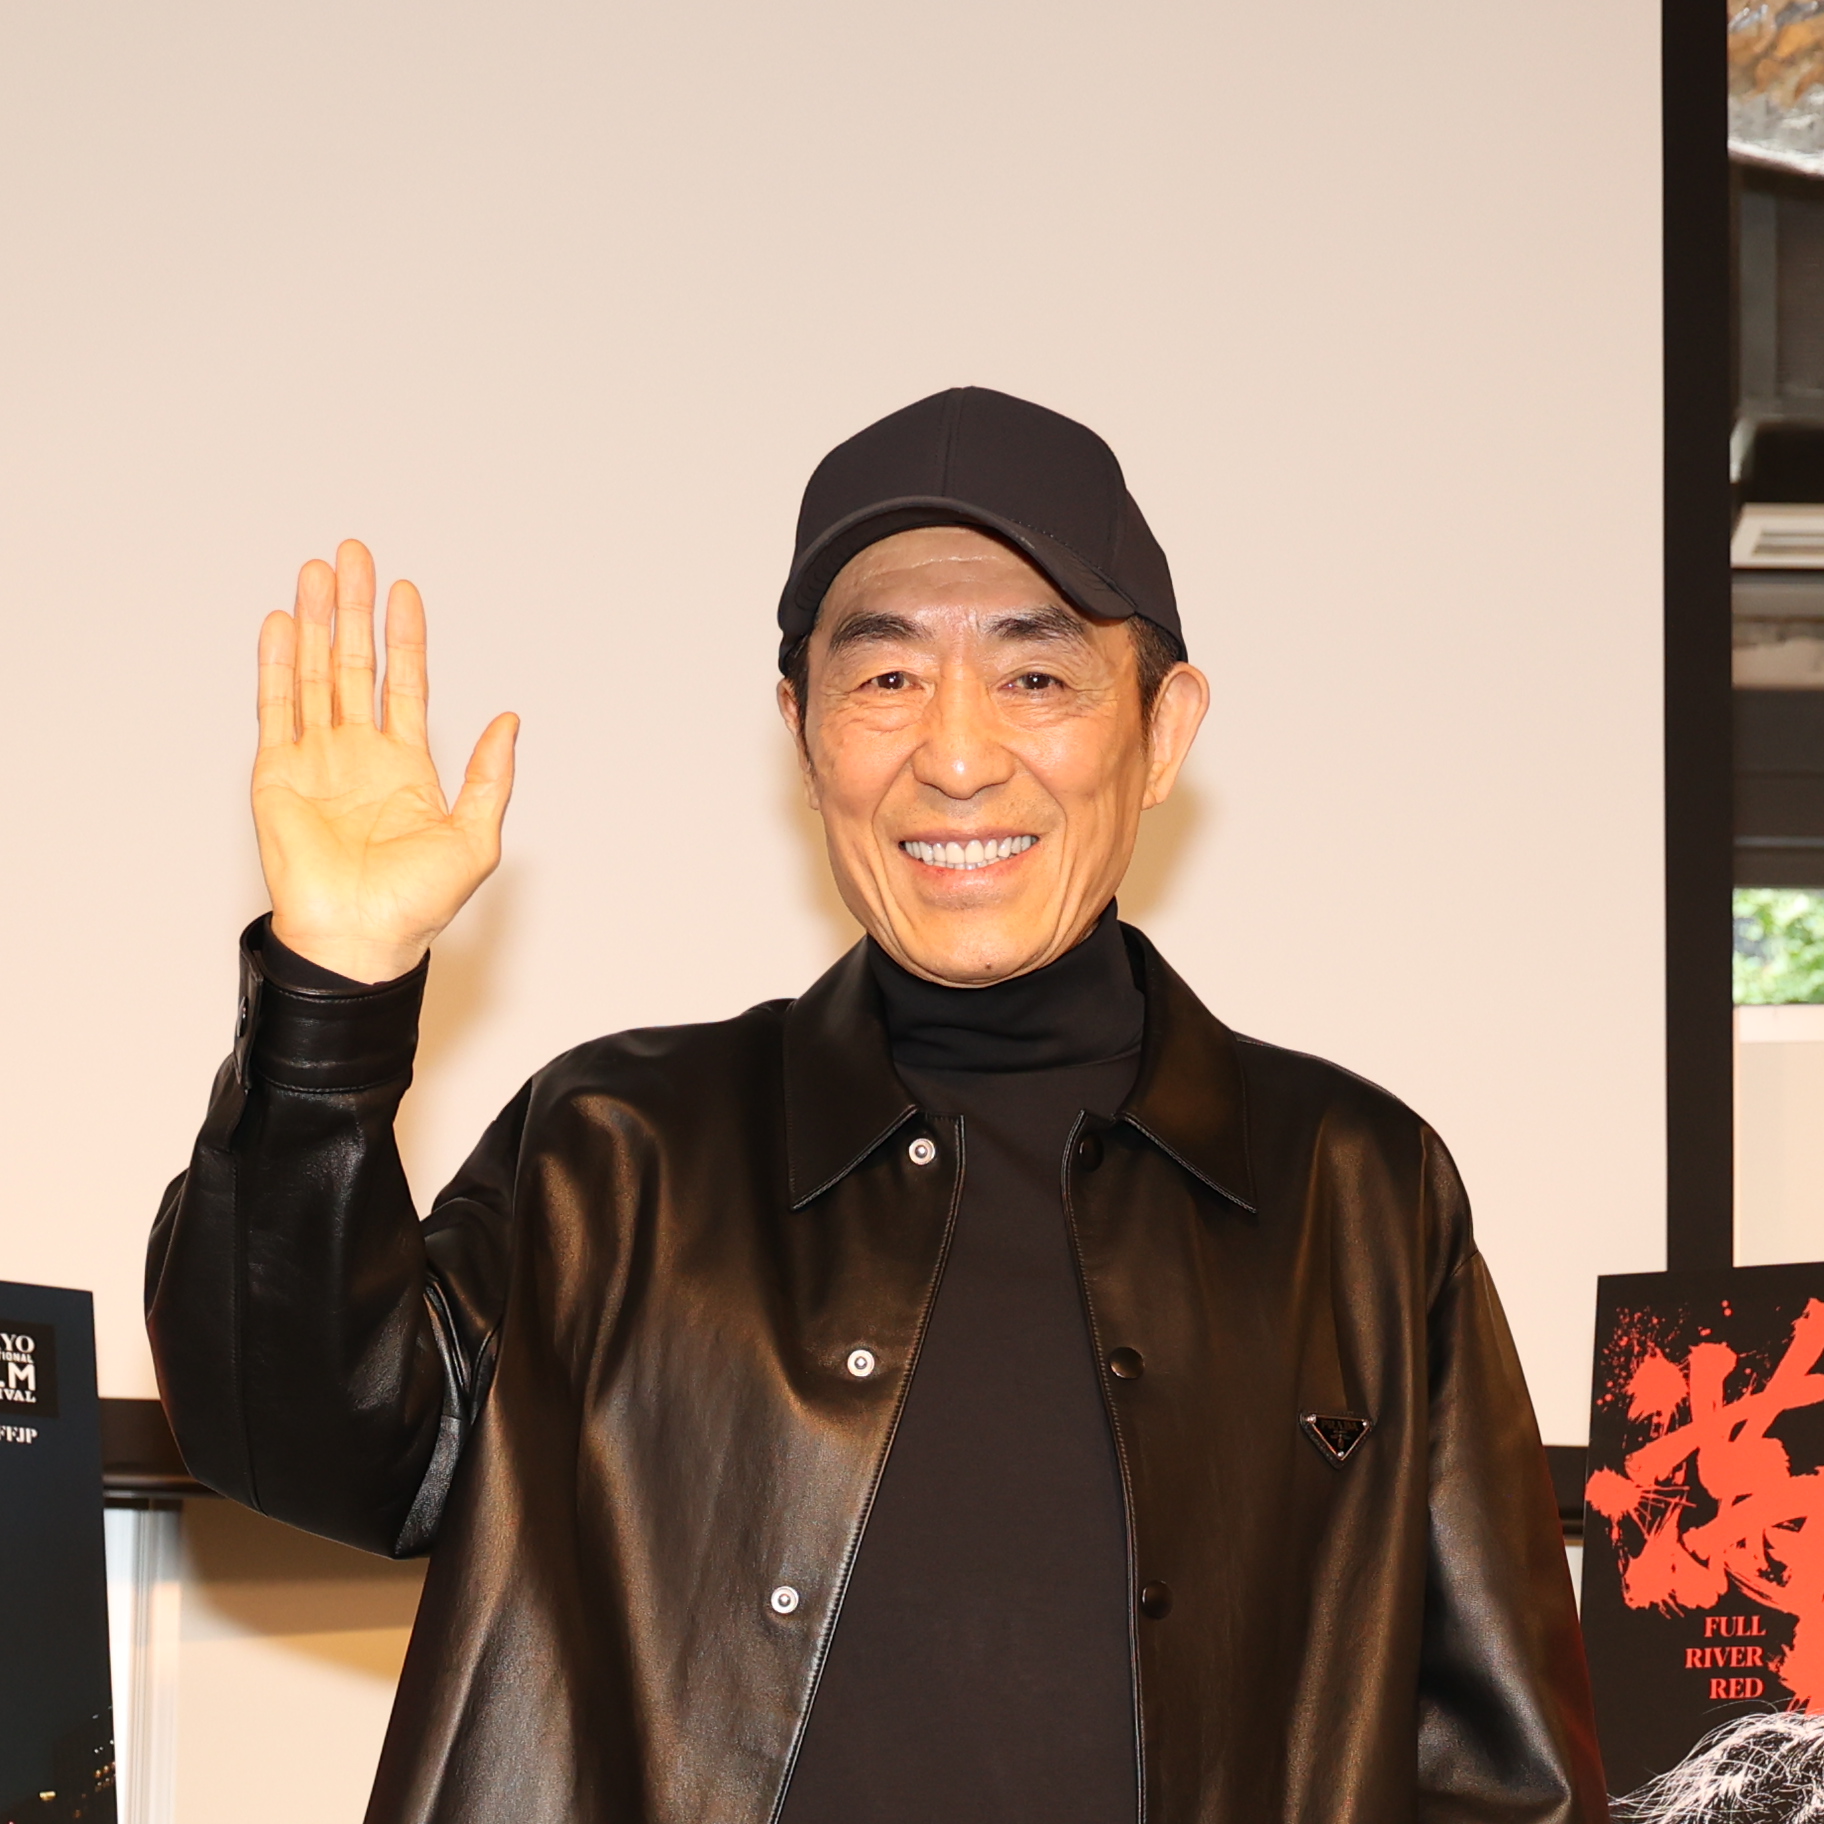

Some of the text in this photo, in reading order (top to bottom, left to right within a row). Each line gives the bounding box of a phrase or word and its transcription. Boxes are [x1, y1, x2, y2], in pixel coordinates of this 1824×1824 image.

[1704, 1615, 1768, 1638] FULL
[1684, 1645, 1764, 1669] RIVER
[1708, 1676, 1764, 1700] RED
